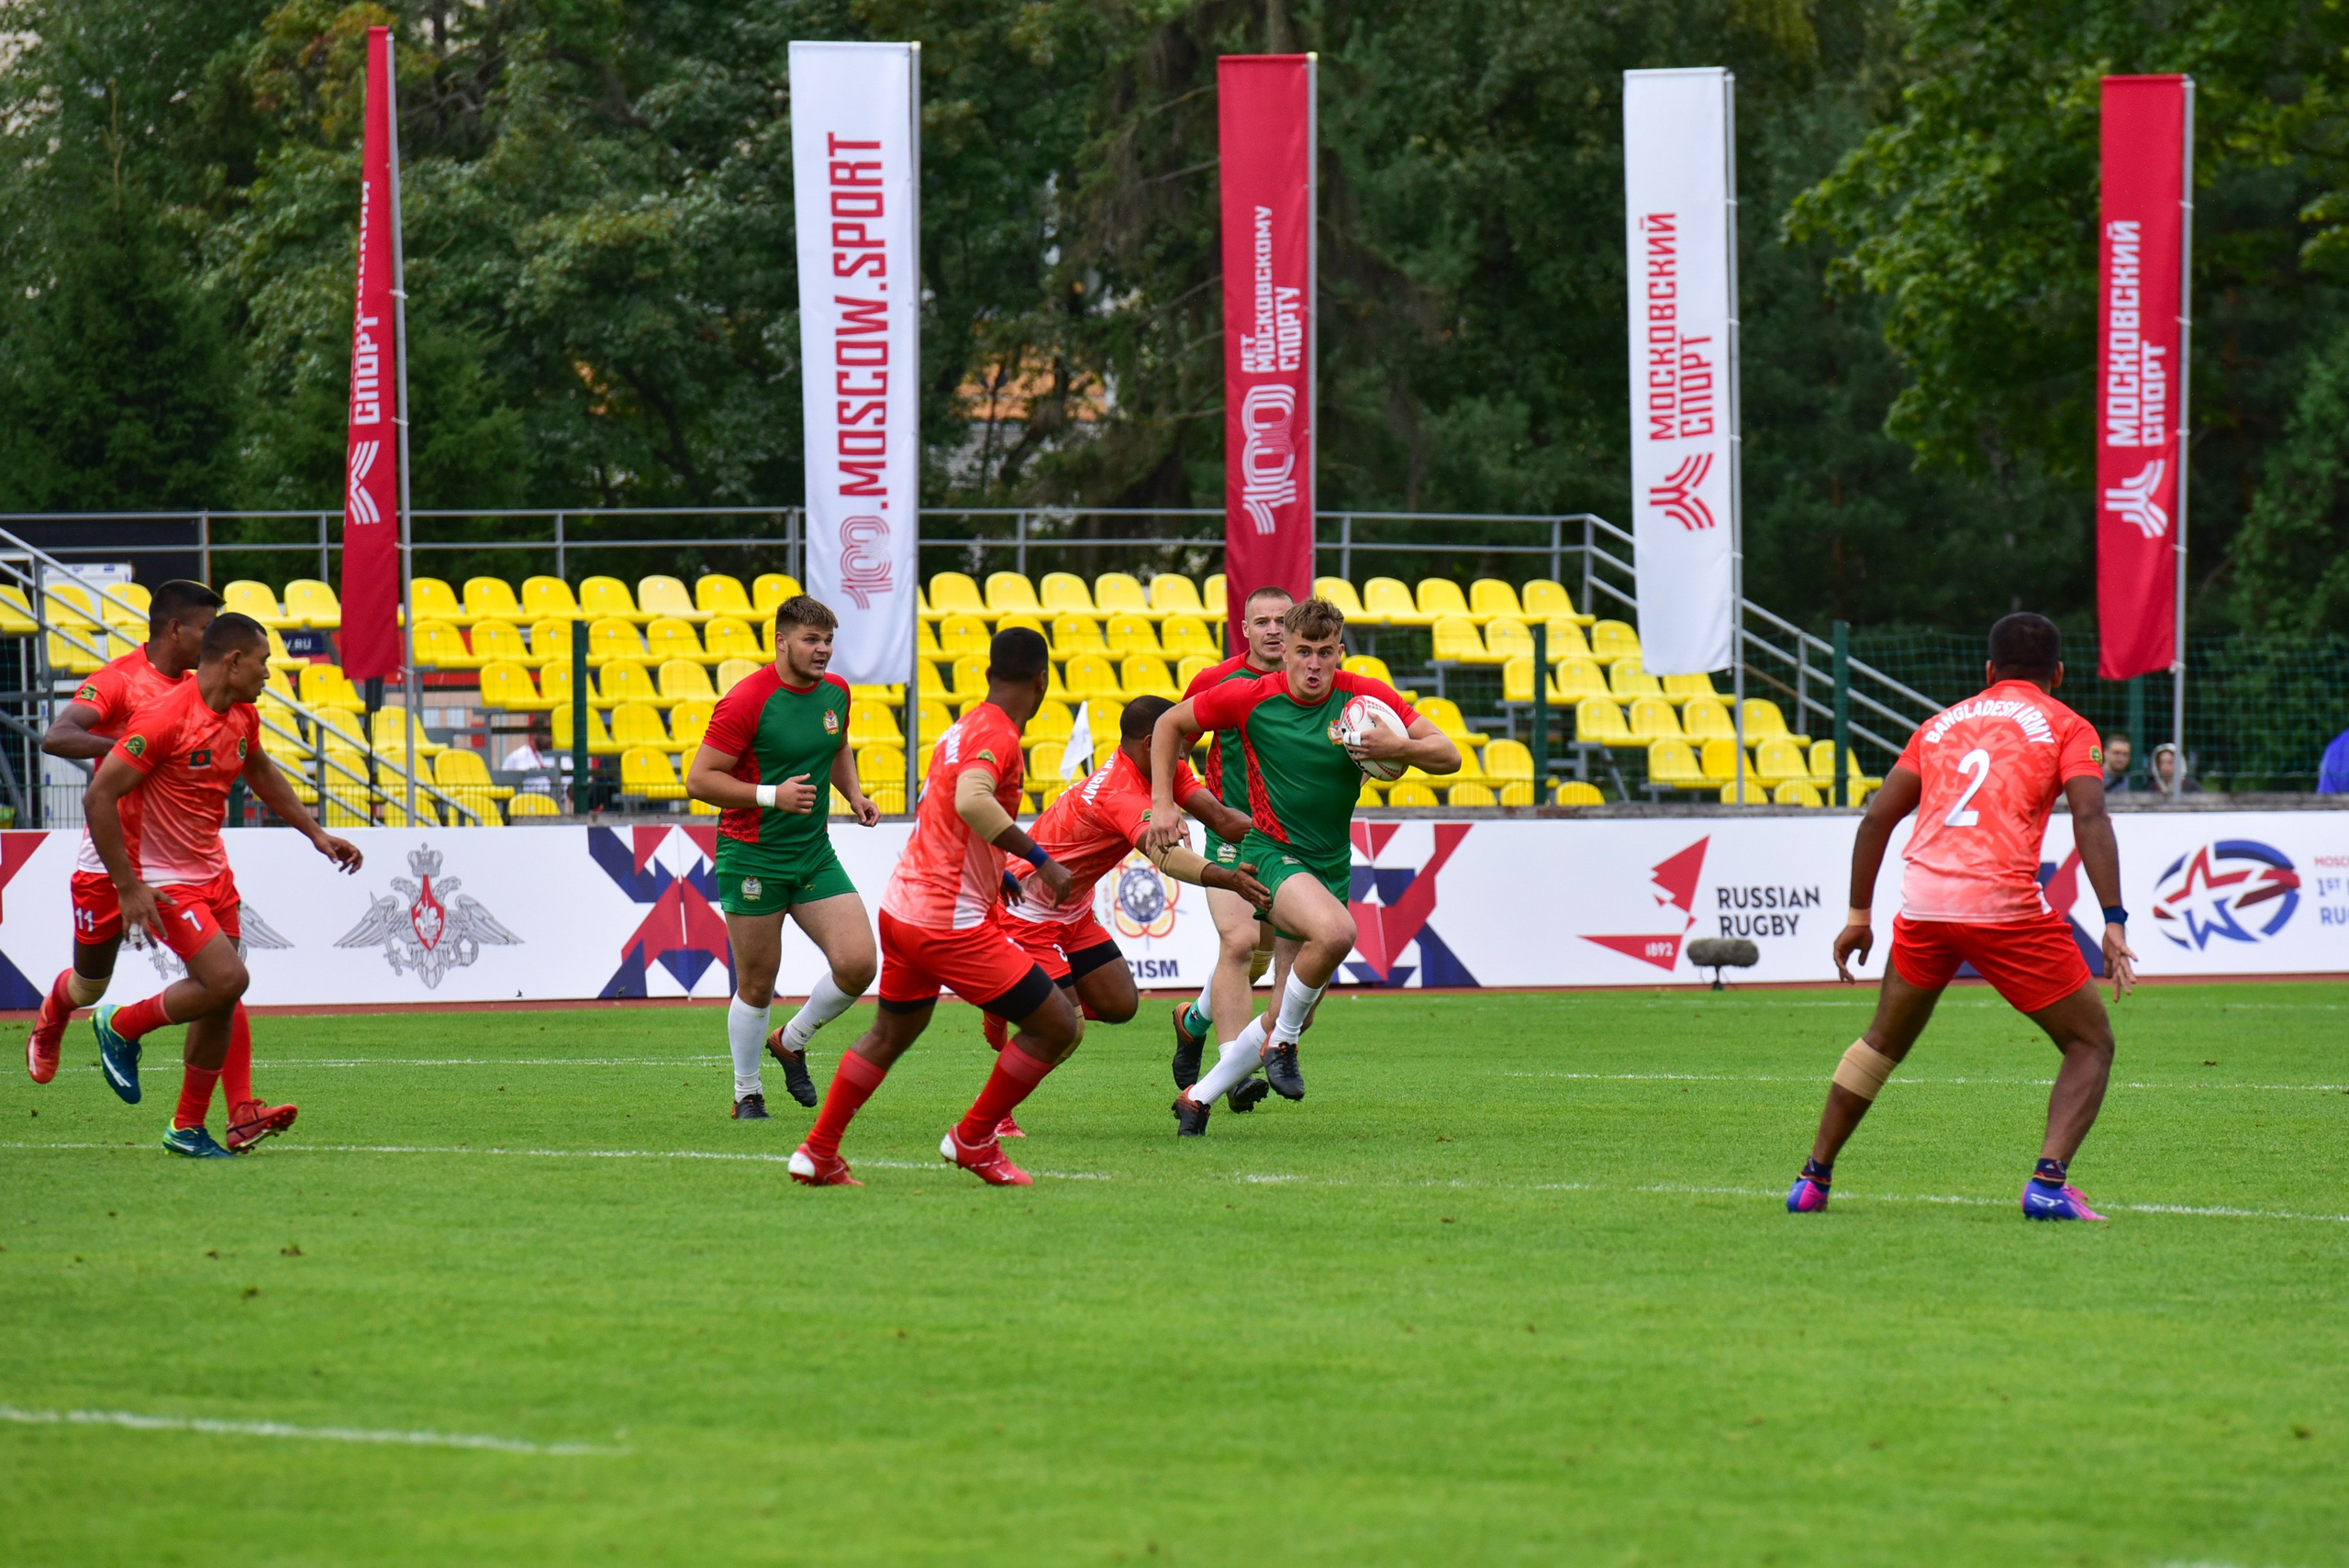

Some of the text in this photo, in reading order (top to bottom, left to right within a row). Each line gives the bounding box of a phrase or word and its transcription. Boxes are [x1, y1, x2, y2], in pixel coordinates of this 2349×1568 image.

[1254, 205, 1276, 373] МОСКОВСКОМУ
[1275, 285, 1303, 372] СПОРТУ
[1639, 212, 1677, 441] МОСКОВСКИЙ
[2106, 220, 2141, 447] МОСКОВСКИЙ
[355, 312, 381, 425] СПОРТ
[1241, 334, 1256, 373] ЛЕТ
[1679, 333, 1715, 439] СПОРТ
[2141, 339, 2167, 447] СПОРТ
[1924, 699, 2055, 744] BANGLADESH ARMY
[1080, 771, 1109, 806] ARMY
[1944, 749, 1990, 827] 2
[75, 906, 94, 933] 11
[1717, 885, 1821, 909] RUSSIAN
[2320, 905, 2349, 925] RU
[180, 909, 204, 932] 7
[1719, 914, 1800, 938] RUGBY
[1644, 941, 1675, 958] 1892
